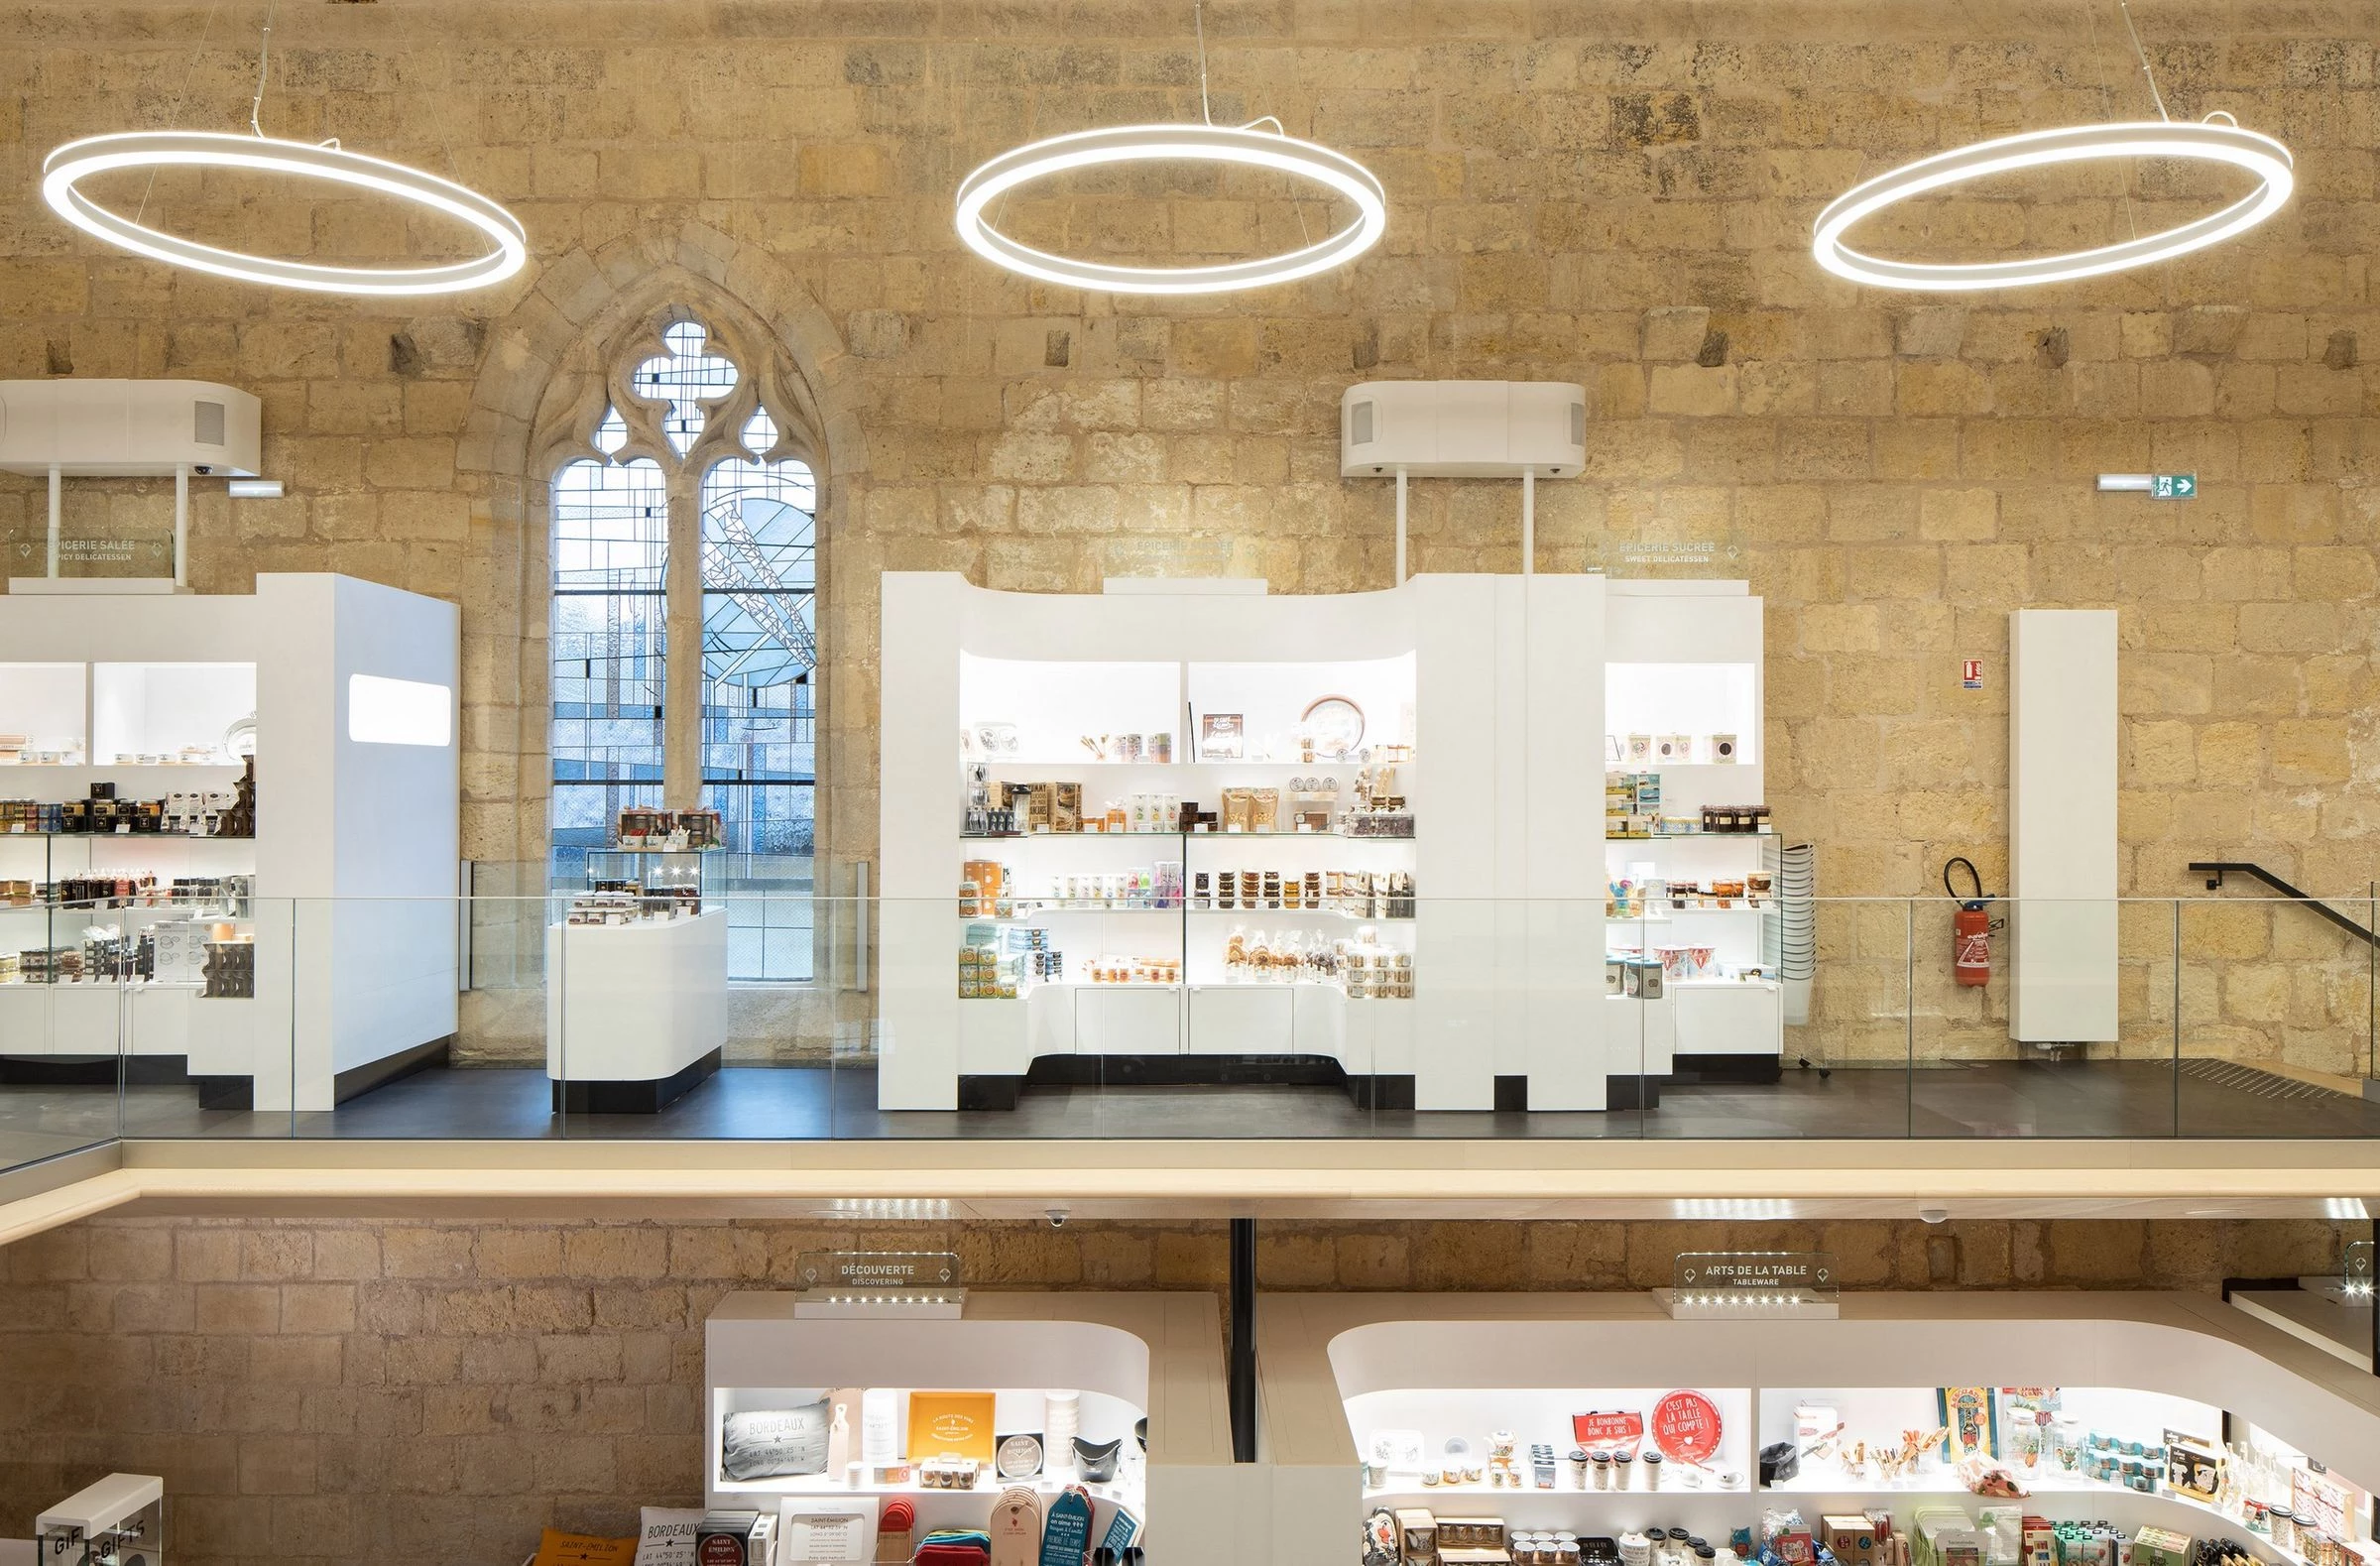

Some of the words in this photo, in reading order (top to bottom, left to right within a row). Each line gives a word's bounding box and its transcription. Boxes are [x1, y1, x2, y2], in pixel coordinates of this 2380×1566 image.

[54, 540, 97, 549] PICERIE
[100, 539, 136, 549] SALÉE
[842, 1263, 914, 1275] DÉCOUVERTE
[1705, 1265, 1734, 1275] ARTS
[1737, 1265, 1752, 1275] DE
[1754, 1265, 1769, 1275] LA
[1772, 1265, 1807, 1275] TABLE
[1685, 1397, 1698, 1408] PAS
[1666, 1411, 1676, 1423] LA
[1677, 1408, 1702, 1421] TAILLE
[749, 1418, 805, 1435] BORDEAUX
[1588, 1426, 1604, 1436] DONC
[1606, 1426, 1612, 1435] JE
[1613, 1425, 1626, 1435] SUIS
[1662, 1425, 1676, 1435] QUI
[1678, 1420, 1703, 1432] COMPTE
[648, 1522, 700, 1539] BORDEAUX
[100, 1520, 145, 1558] GIFTS
